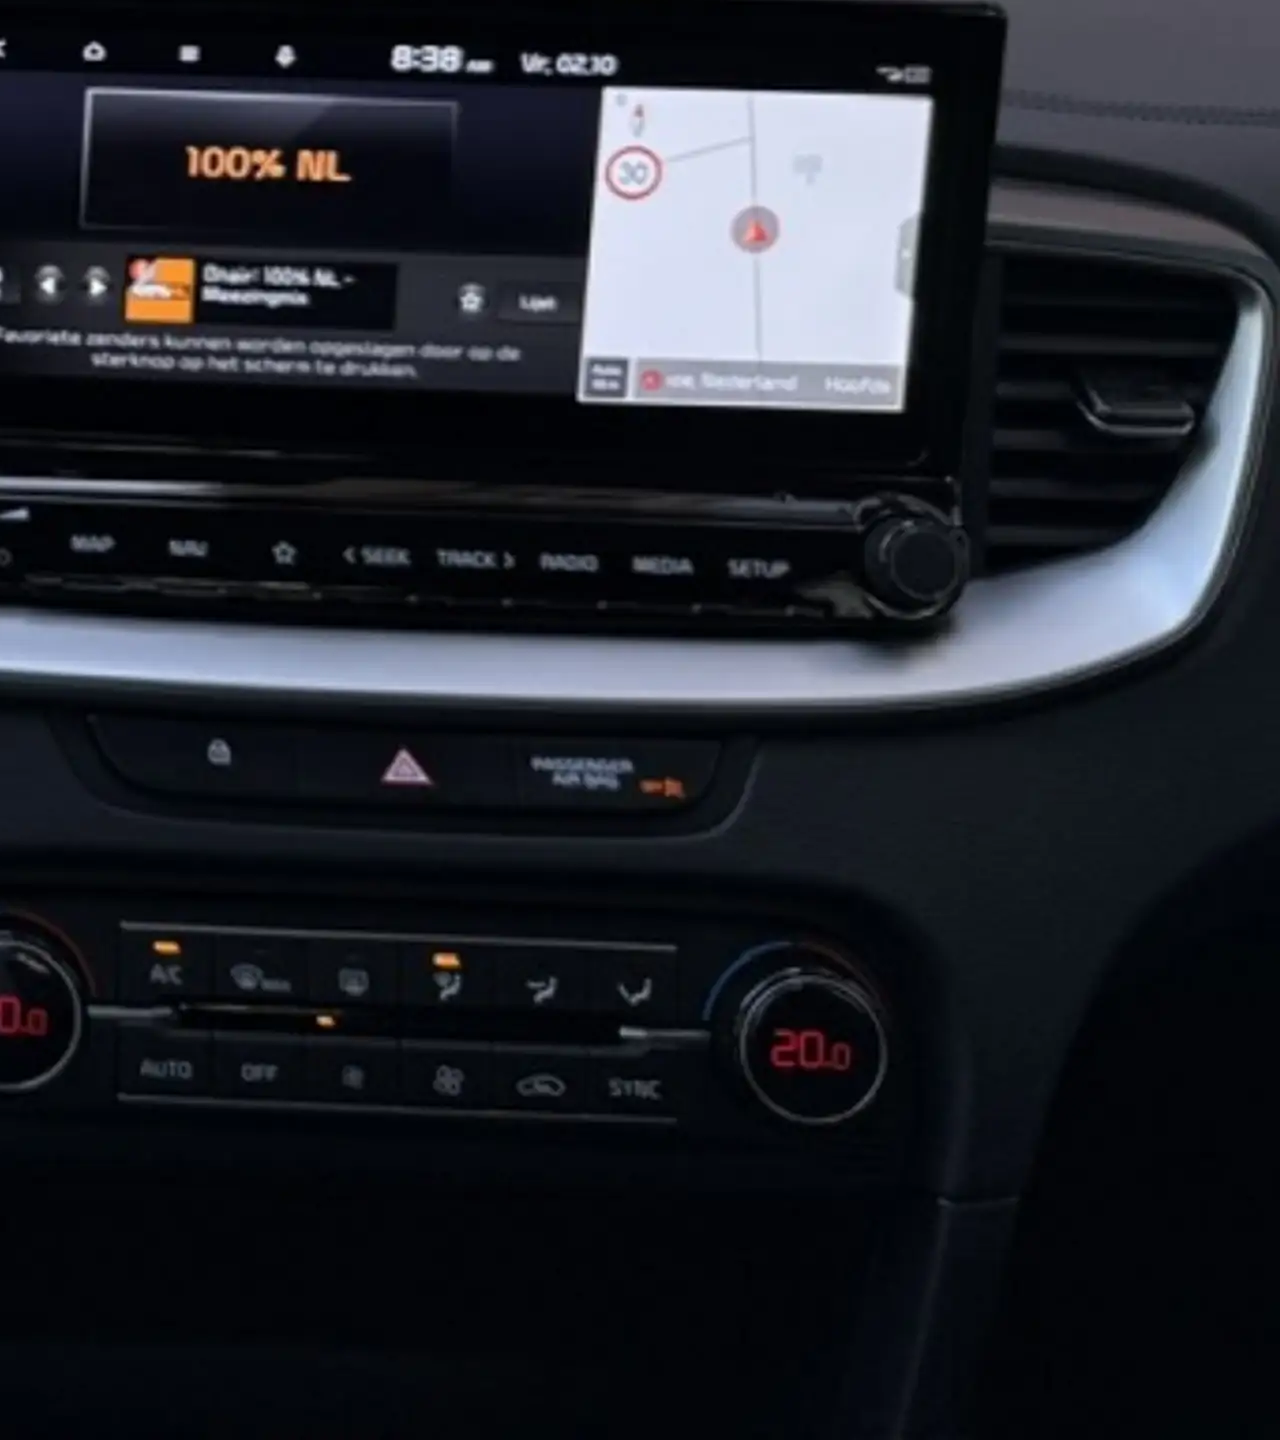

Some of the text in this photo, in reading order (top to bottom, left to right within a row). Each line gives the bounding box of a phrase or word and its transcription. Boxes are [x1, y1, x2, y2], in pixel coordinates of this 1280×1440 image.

[391, 44, 464, 72] 8:38
[186, 146, 352, 182] 100% NL
[69, 534, 116, 553] MAP
[360, 545, 412, 566] SEEK
[437, 547, 497, 569] TRACK
[540, 552, 600, 573] RADIO
[631, 555, 696, 575] MEDIA
[726, 558, 790, 579] SETUP
[770, 1028, 852, 1071] 20.0
[141, 1061, 194, 1080] AUTO
[241, 1063, 279, 1082] OFF
[608, 1078, 662, 1100] SYNC
